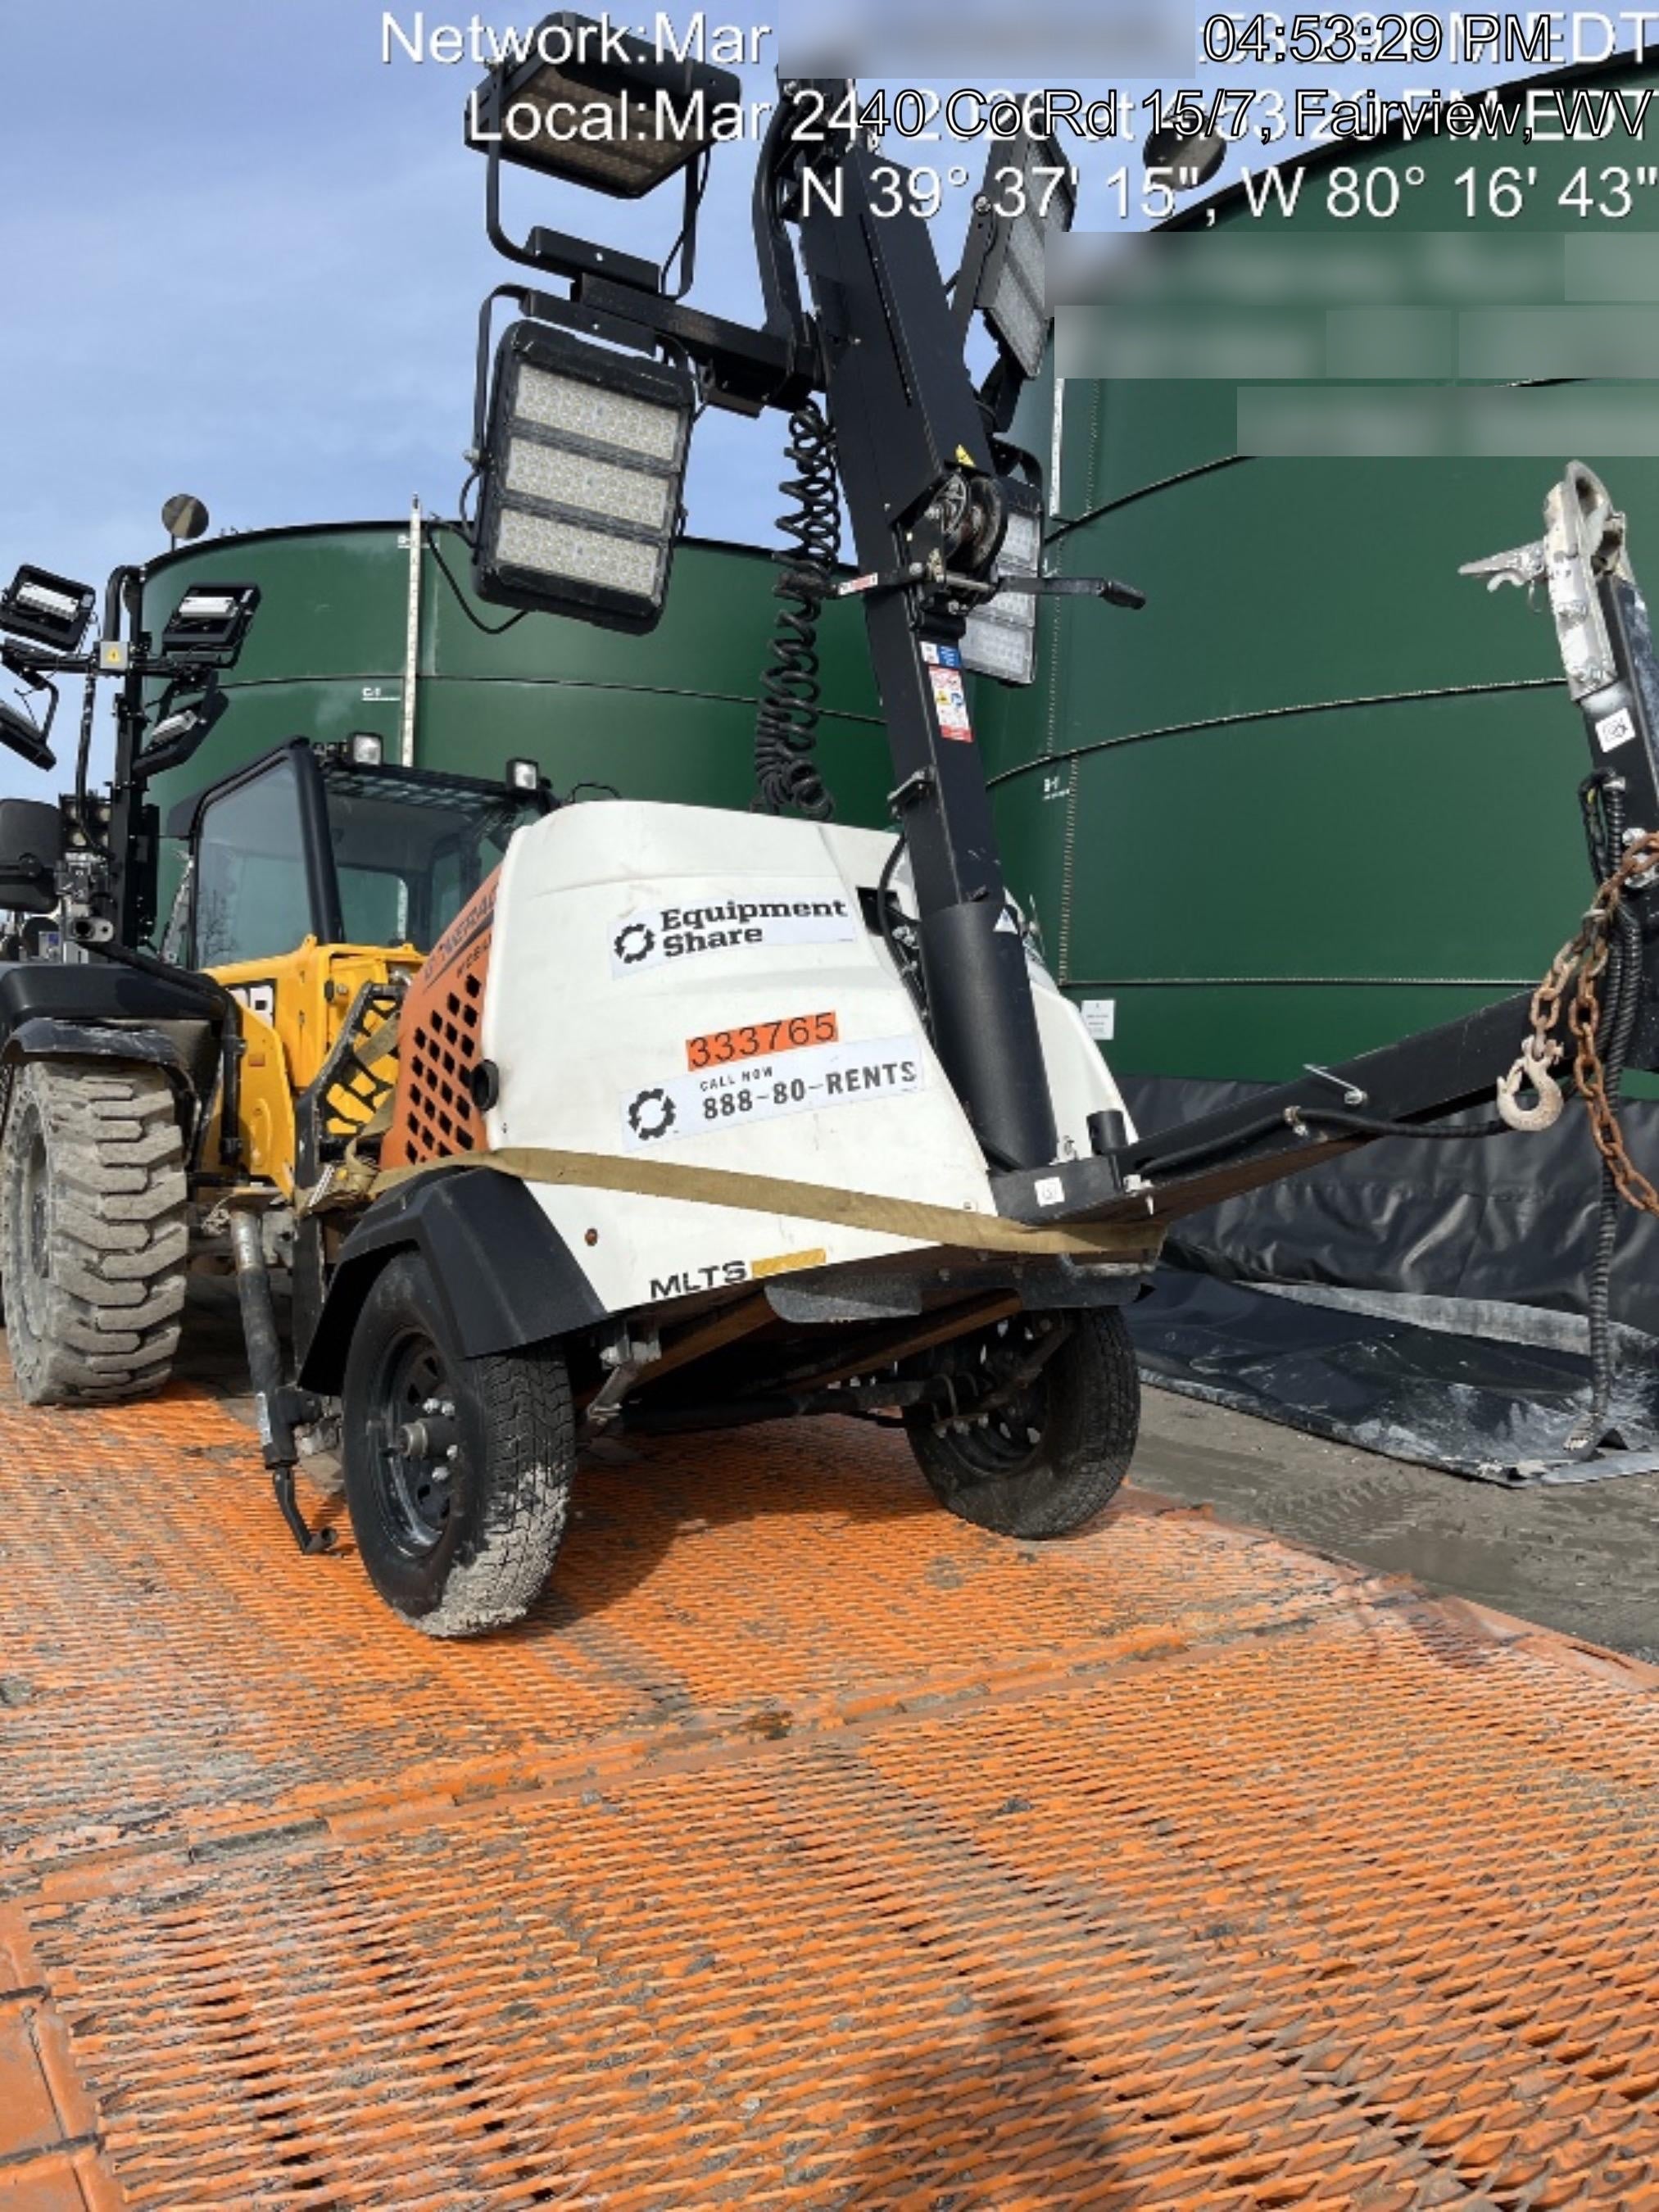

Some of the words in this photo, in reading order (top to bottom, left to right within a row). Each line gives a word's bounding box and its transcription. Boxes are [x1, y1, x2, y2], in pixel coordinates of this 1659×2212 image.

[660, 899, 849, 931] Equipment
[662, 927, 764, 957] Share
[689, 1011, 836, 1068] 333765
[700, 1075, 735, 1092] CALL
[741, 1066, 774, 1082] NOW
[703, 1060, 918, 1120] 888-80-RENTS
[650, 1260, 747, 1299] MLTS
